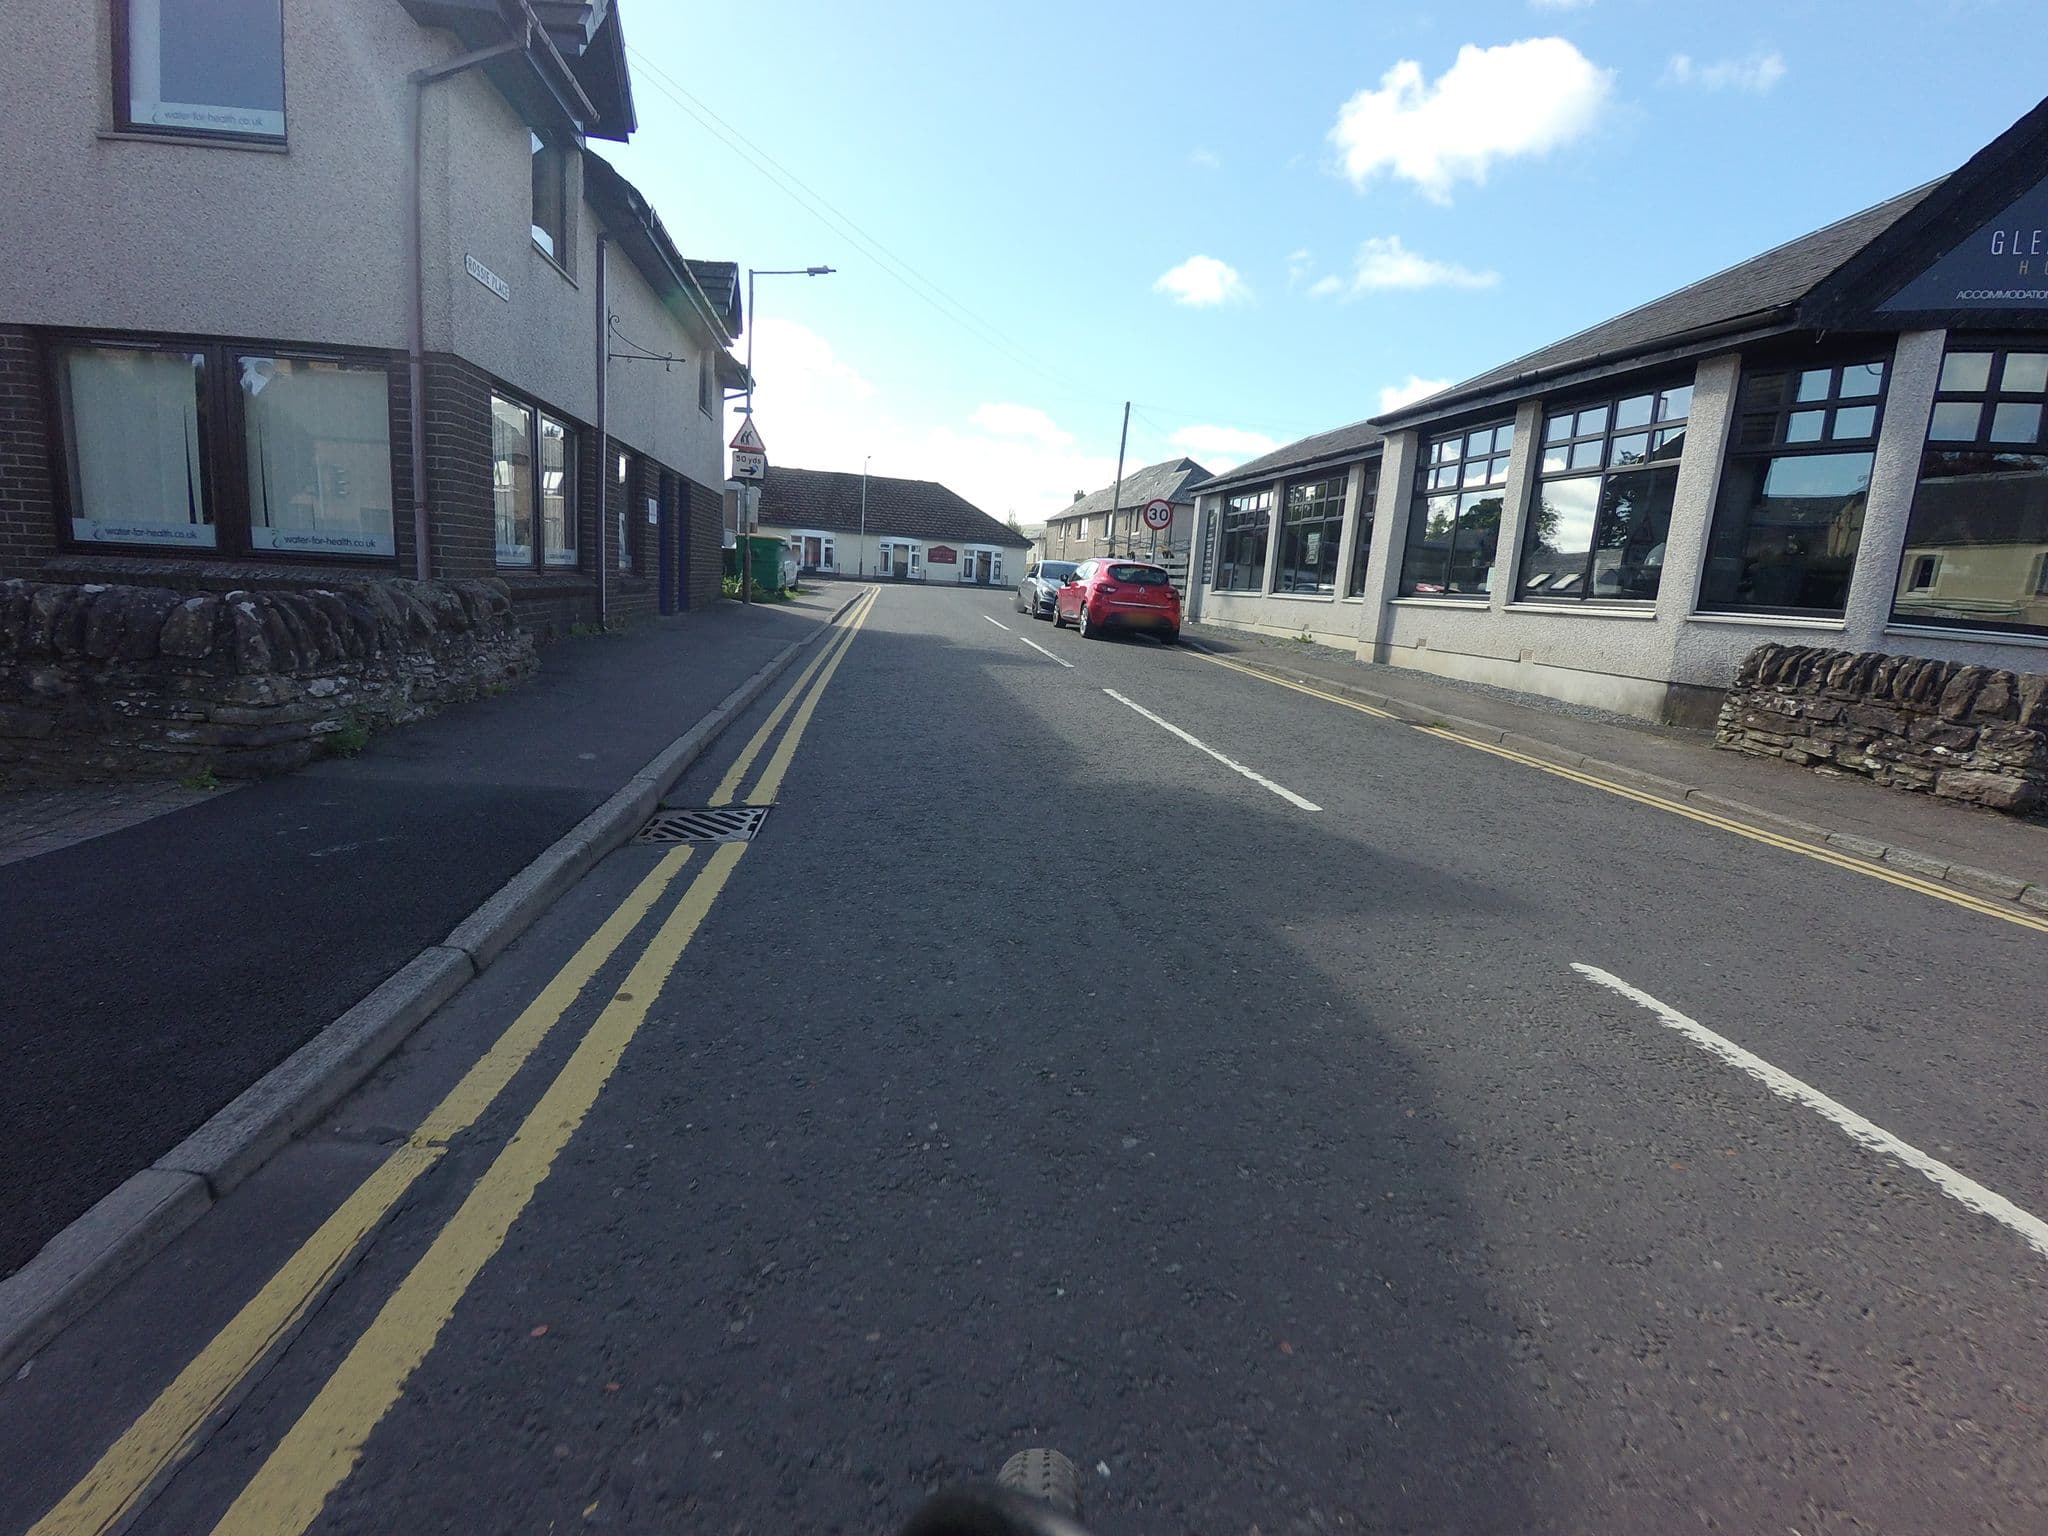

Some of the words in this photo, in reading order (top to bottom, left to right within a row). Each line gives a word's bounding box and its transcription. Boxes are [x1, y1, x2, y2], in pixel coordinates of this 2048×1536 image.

[1991, 230, 2048, 255] GLE
[491, 275, 510, 299] PLACE
[735, 454, 747, 463] 50
[748, 456, 762, 465] yds
[1149, 508, 1169, 521] 30
